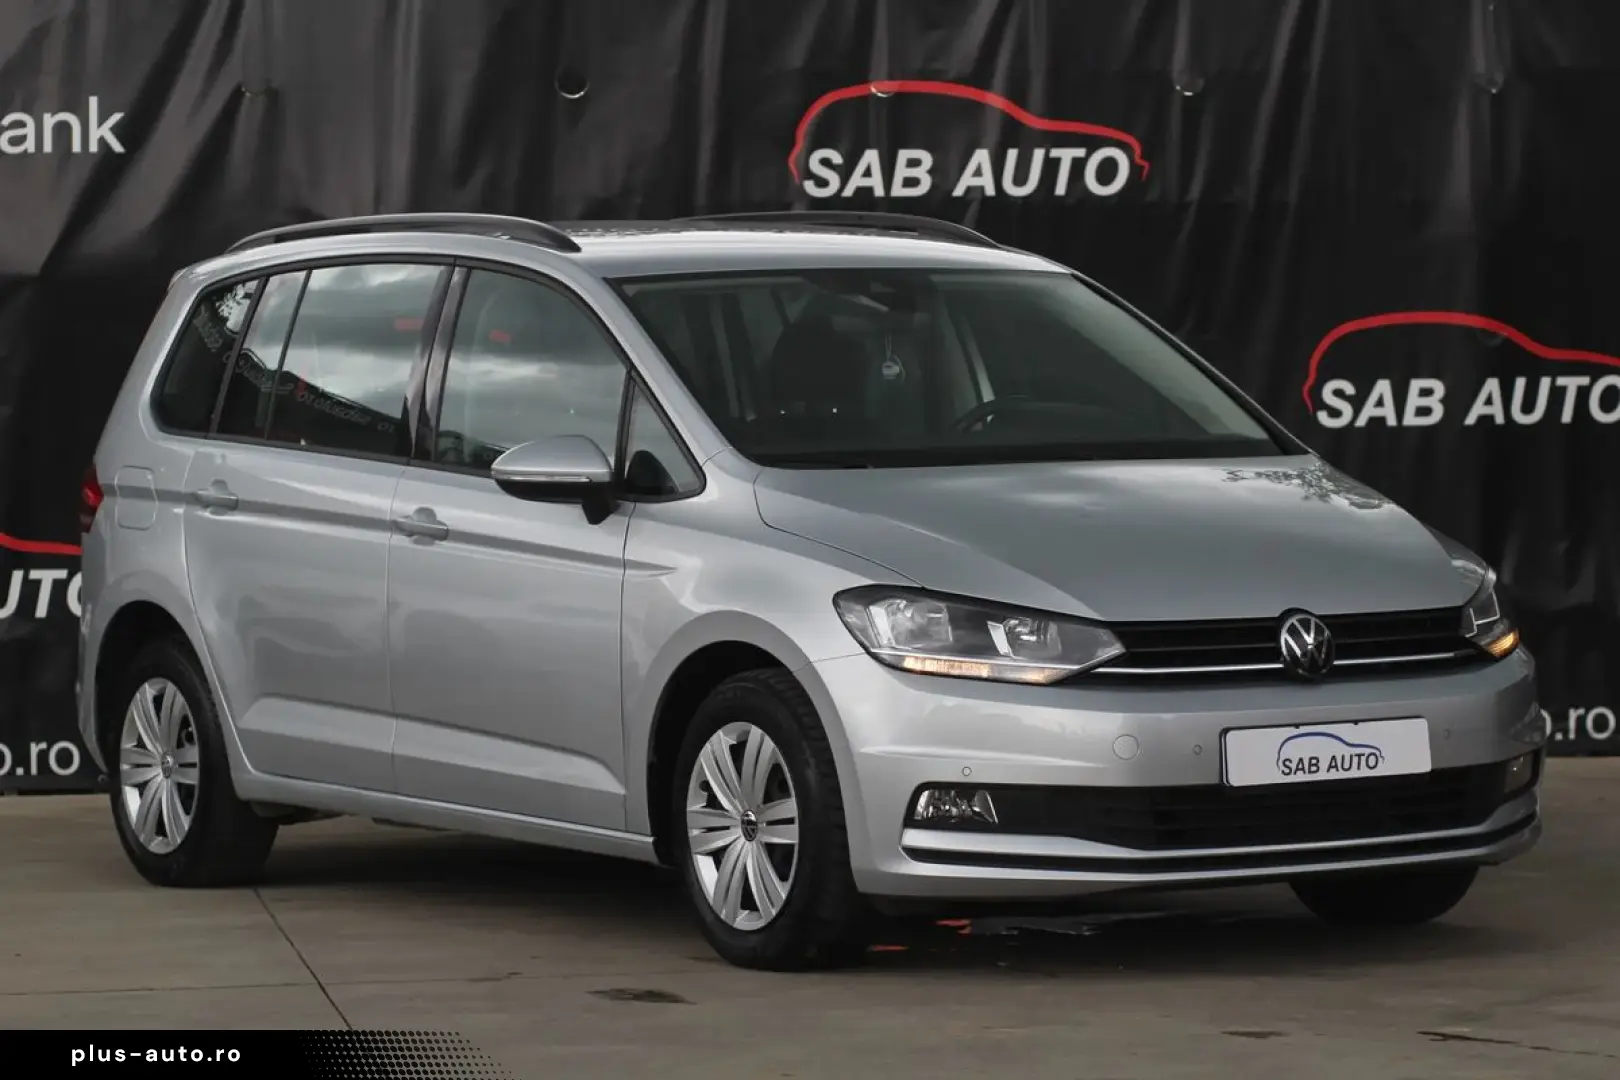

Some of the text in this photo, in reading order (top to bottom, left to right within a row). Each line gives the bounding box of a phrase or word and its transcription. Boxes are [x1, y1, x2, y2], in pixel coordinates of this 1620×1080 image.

[0, 95, 125, 154] ank
[802, 146, 1130, 198] SAB AUTO
[1316, 374, 1620, 428] SAB AUTO
[1280, 751, 1379, 776] SAB AUTO
